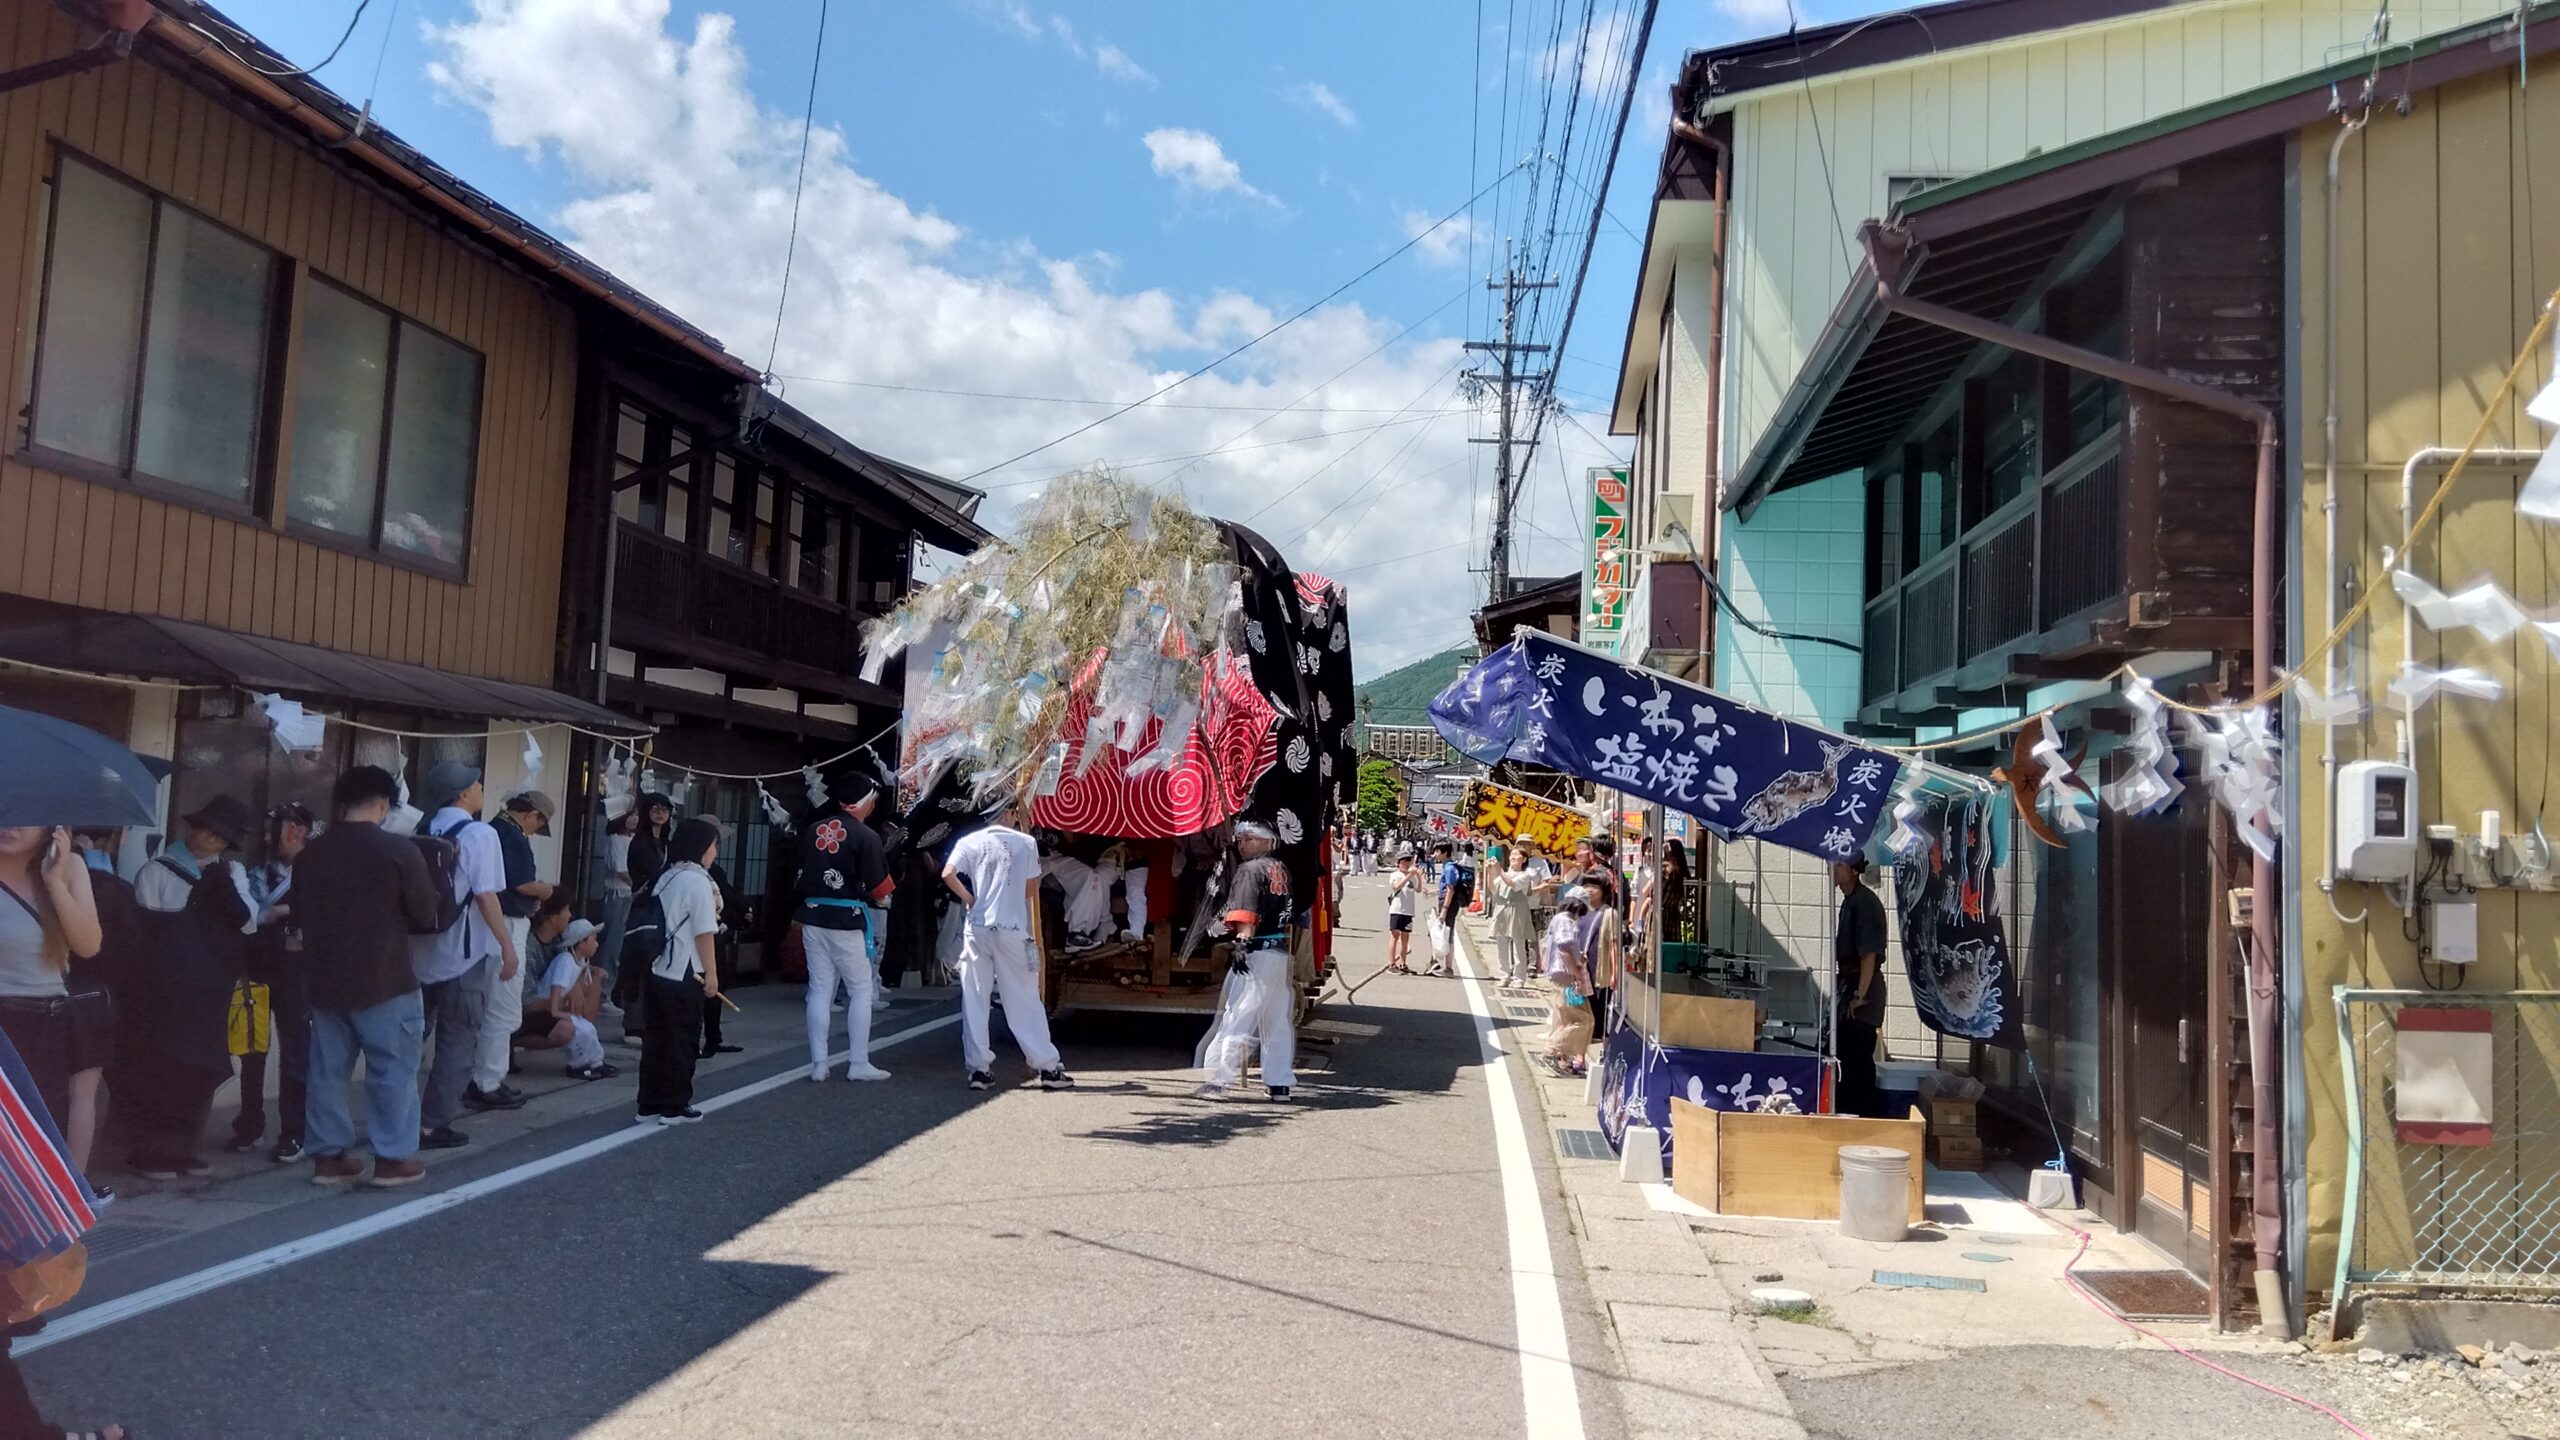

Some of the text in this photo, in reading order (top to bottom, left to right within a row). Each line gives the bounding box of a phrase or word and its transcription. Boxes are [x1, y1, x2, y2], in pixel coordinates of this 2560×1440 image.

[1594, 516, 1625, 628] フジカラー
[1526, 653, 1566, 753] 炭火焼
[1582, 676, 1737, 756] いわな
[1591, 733, 1738, 812] 塩焼き
[1819, 757, 1883, 857] 炭火焼
[1475, 798, 1592, 857] 大阪焼
